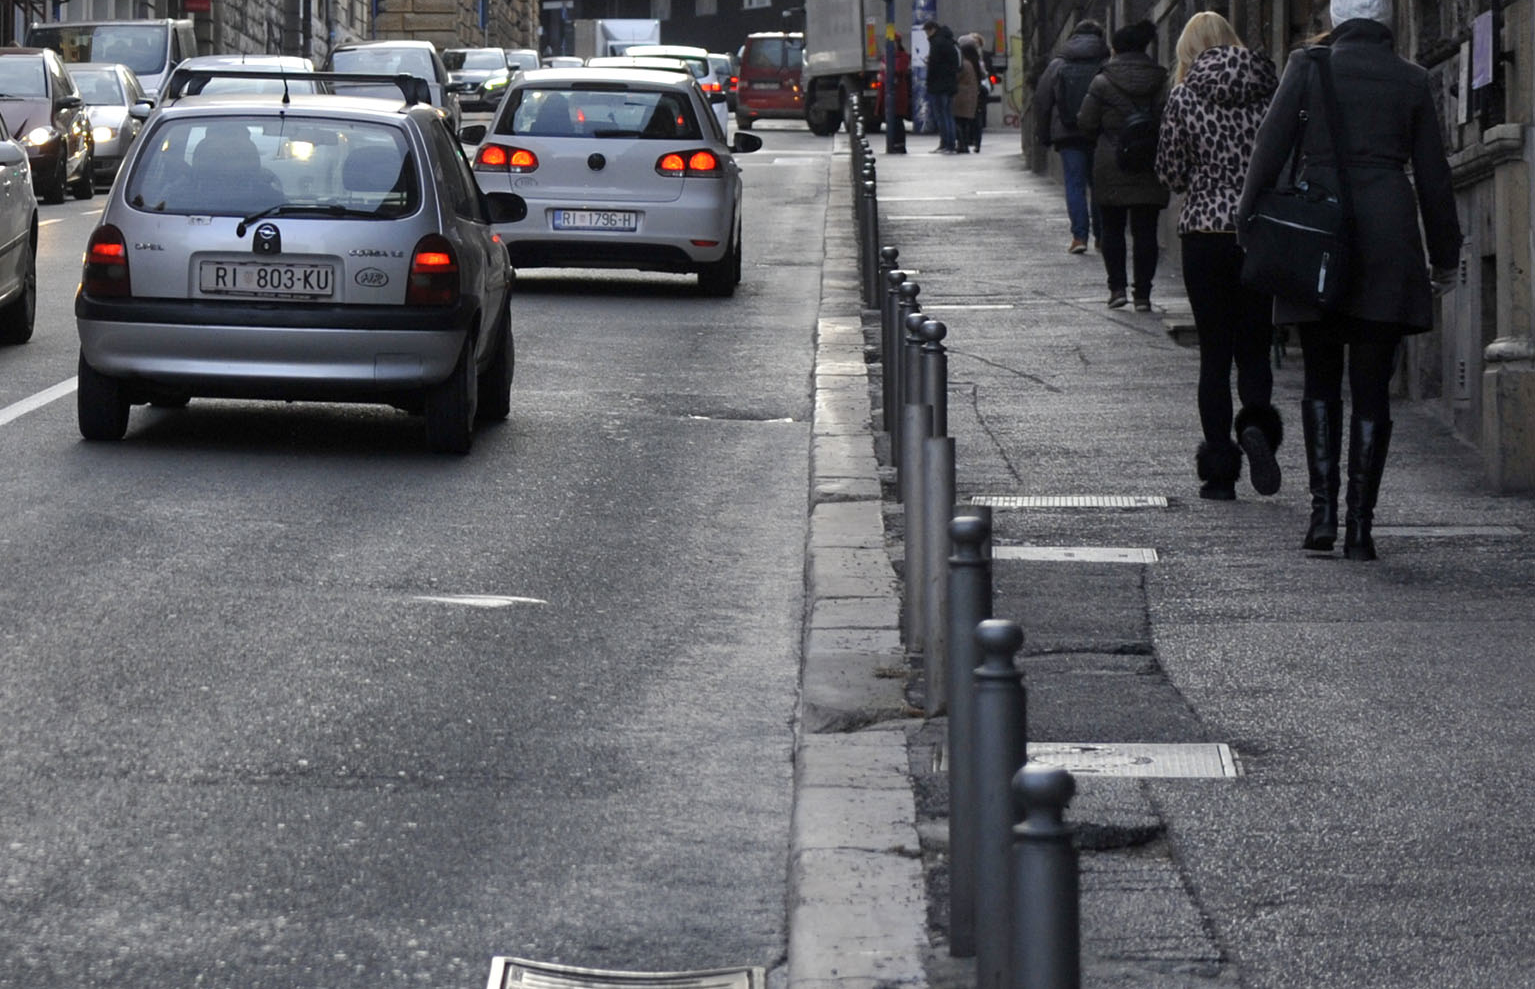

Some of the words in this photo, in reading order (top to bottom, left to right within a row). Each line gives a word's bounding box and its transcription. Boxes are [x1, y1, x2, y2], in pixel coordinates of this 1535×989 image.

[562, 212, 576, 224] RI
[588, 213, 631, 227] 1796-H
[215, 267, 237, 287] RI
[256, 268, 329, 290] 803-KU
